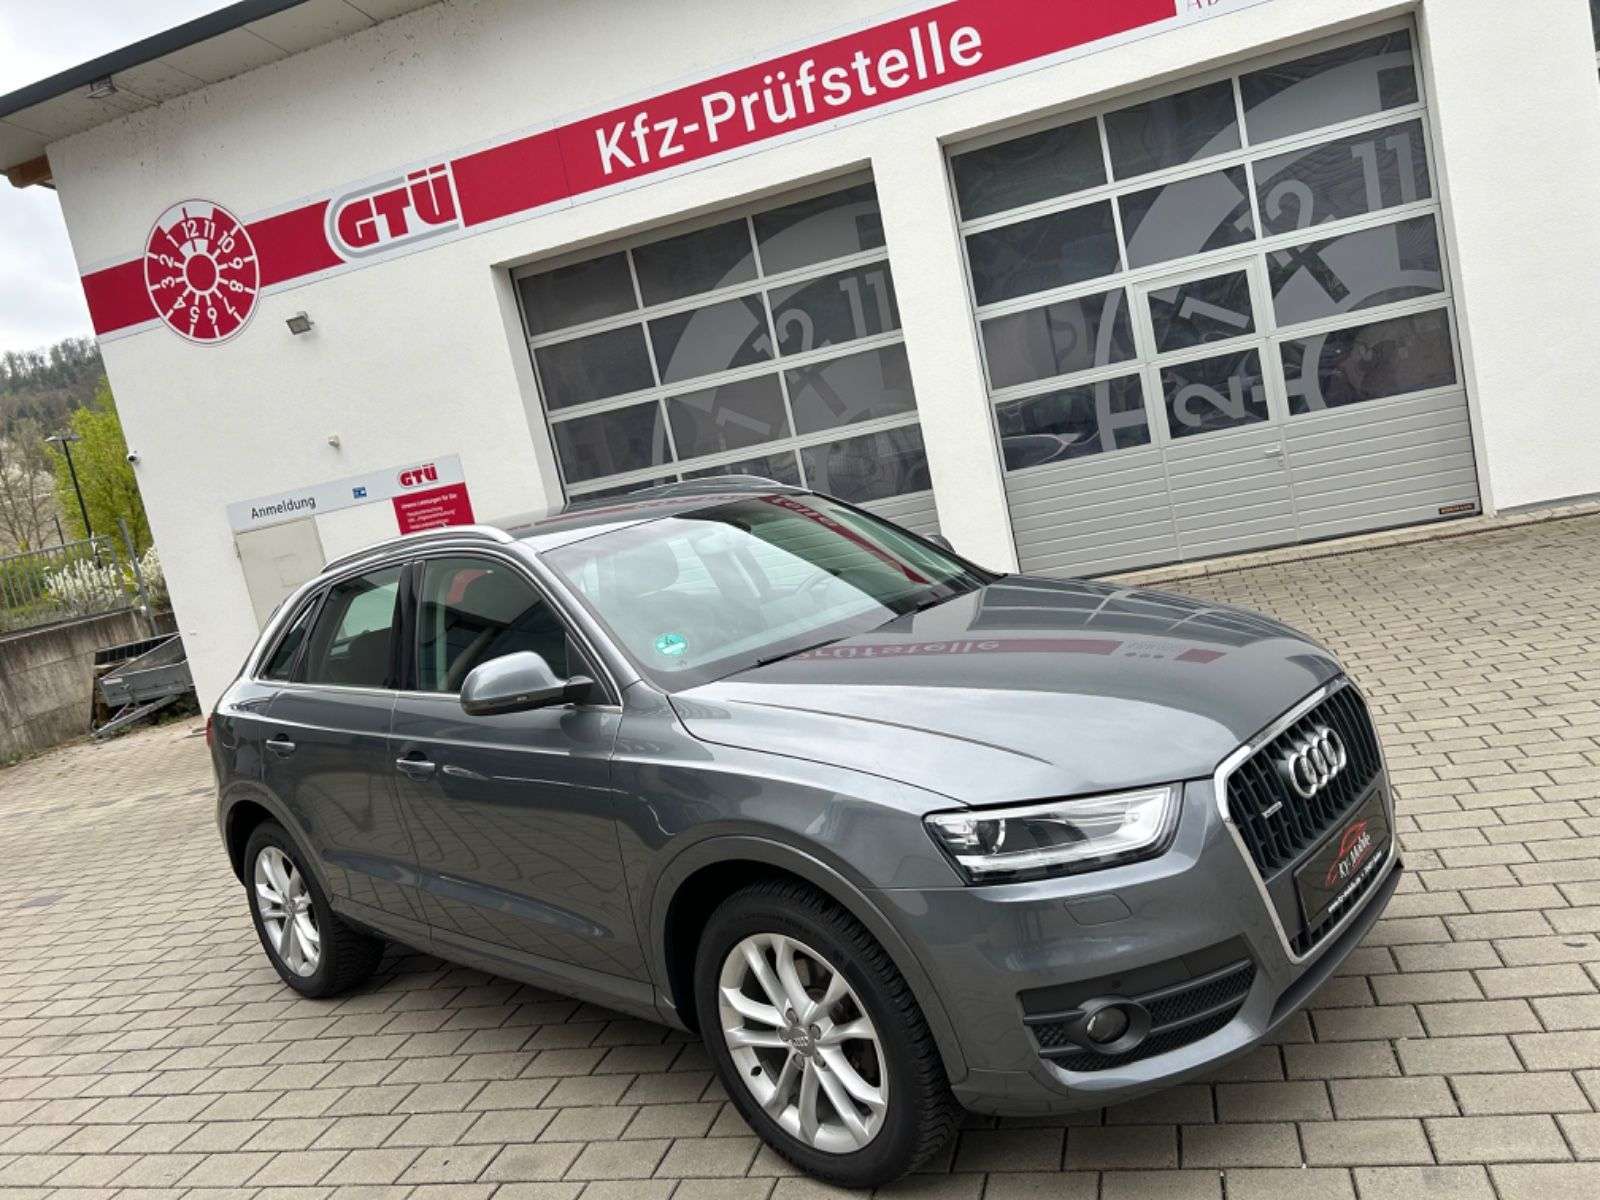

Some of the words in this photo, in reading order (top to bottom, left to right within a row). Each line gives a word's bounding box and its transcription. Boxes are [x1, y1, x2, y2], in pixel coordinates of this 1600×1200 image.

[595, 21, 983, 175] Kfz-Prüfstelle
[338, 163, 457, 248] GTÜ
[182, 220, 199, 239] 12
[203, 219, 216, 240] 11
[217, 230, 235, 253] 10
[229, 280, 244, 292] 8
[400, 463, 438, 486] GTÜ
[251, 497, 316, 519] Anmeldung
